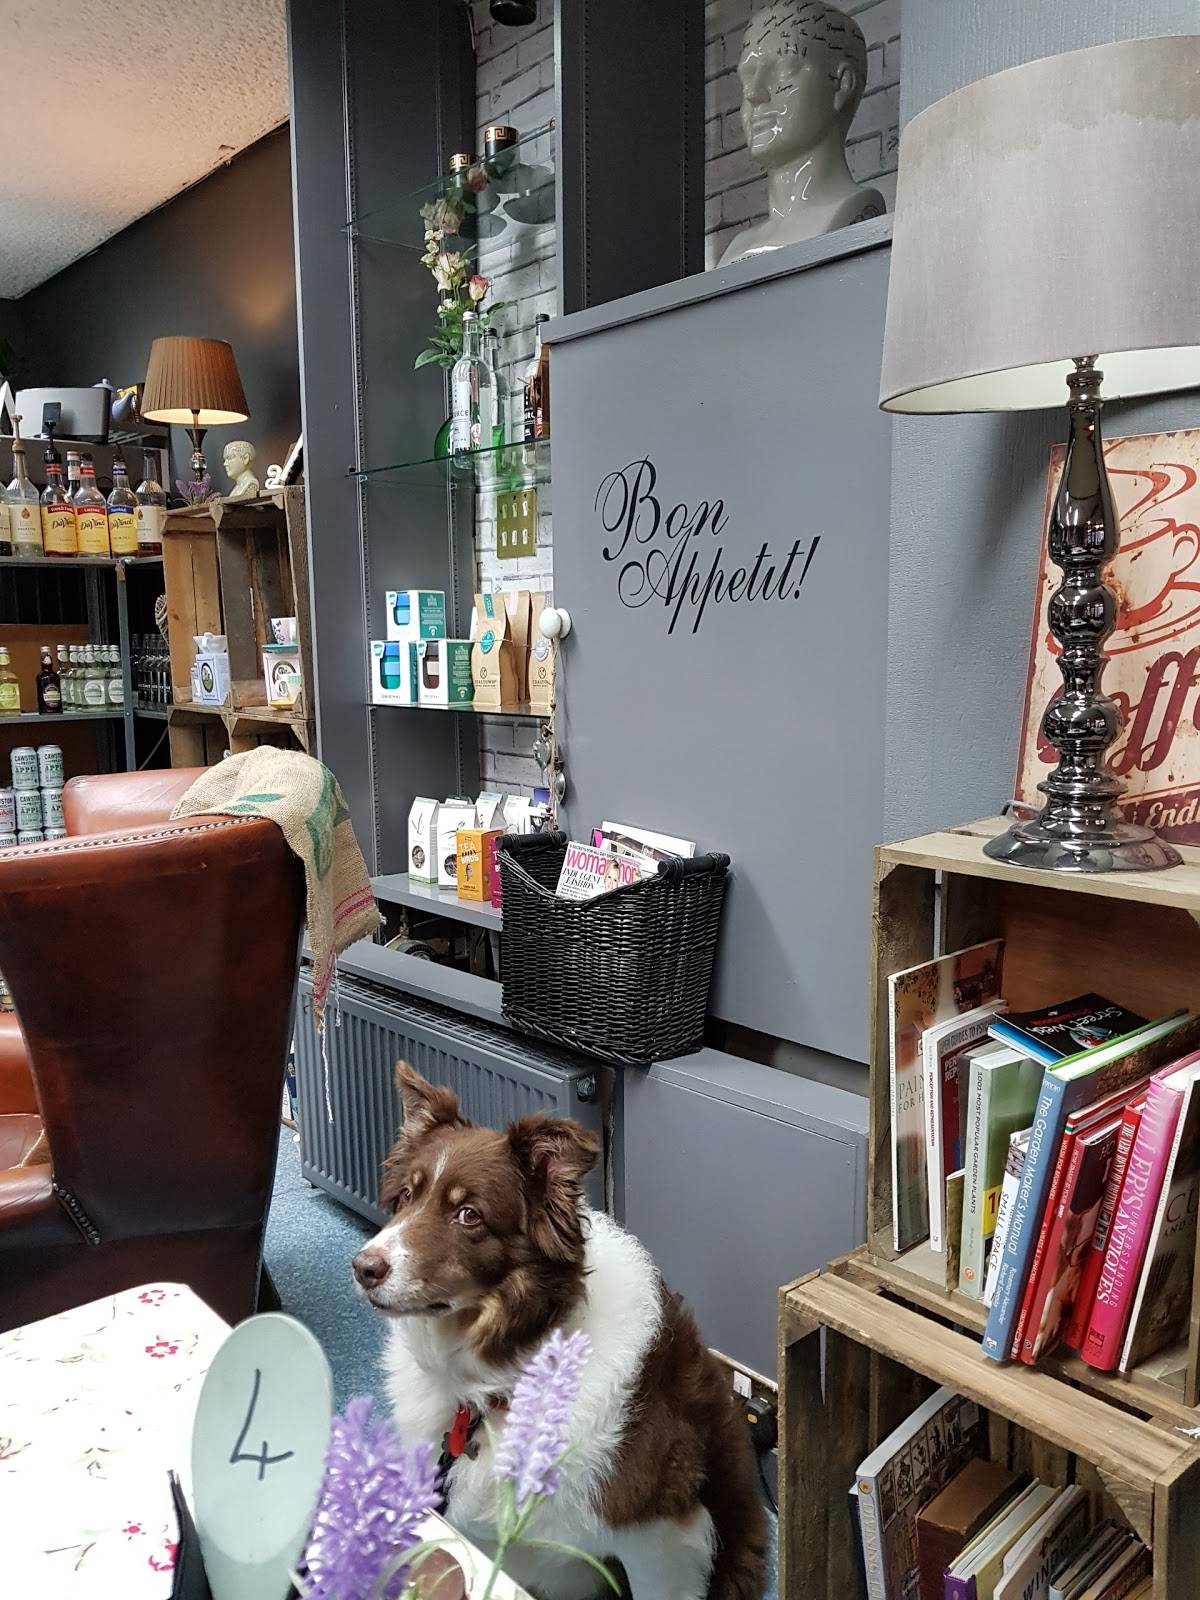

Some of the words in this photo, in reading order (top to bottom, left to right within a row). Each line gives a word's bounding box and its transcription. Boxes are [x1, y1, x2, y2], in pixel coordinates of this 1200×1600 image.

[595, 455, 729, 561] Bon
[618, 524, 822, 634] Appetit!
[567, 848, 607, 876] woma
[1038, 1095, 1053, 1117] The
[1027, 1118, 1047, 1165] Garden
[1121, 1092, 1164, 1212] MILLER'S
[971, 1152, 979, 1184] GARDEN
[1016, 1164, 1036, 1210] Maker's
[969, 1185, 977, 1214] PLANTS
[996, 1191, 1009, 1228] SMALL
[988, 1232, 1002, 1271] SPACE
[1006, 1210, 1026, 1255] Manual
[1096, 1204, 1131, 1304] ANTIQUES
[1110, 1210, 1141, 1307] UNDERSTANDING
[229, 1368, 295, 1481] 4
